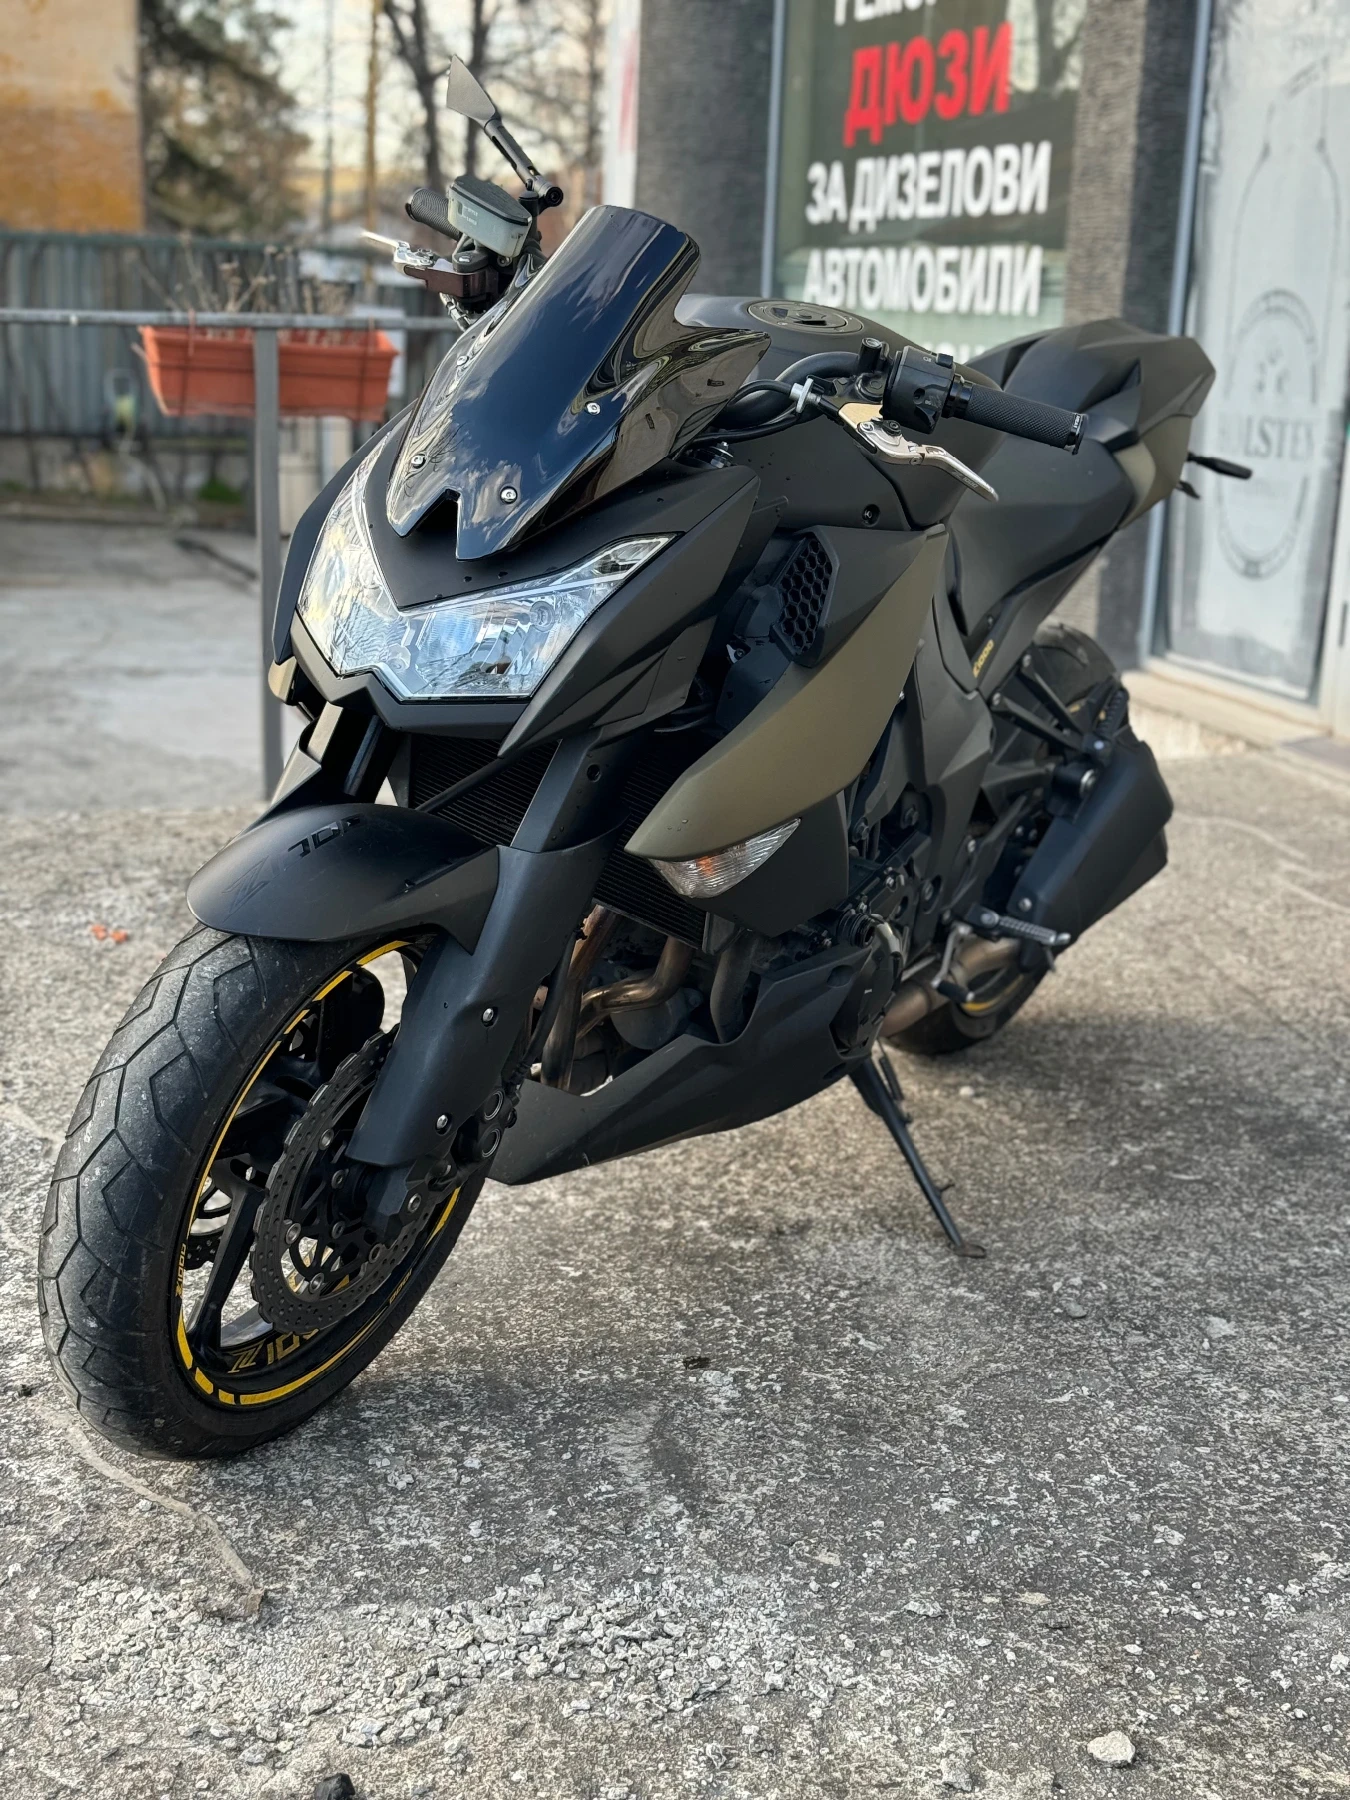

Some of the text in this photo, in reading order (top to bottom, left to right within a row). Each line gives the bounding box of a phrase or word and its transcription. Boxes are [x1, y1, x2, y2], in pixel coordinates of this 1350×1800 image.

[843, 21, 1013, 148] ДЮЗИ
[805, 140, 1052, 234] ЗА ДИЗЕЛОВИ
[803, 245, 1044, 317] АВТОМОБИЛИ
